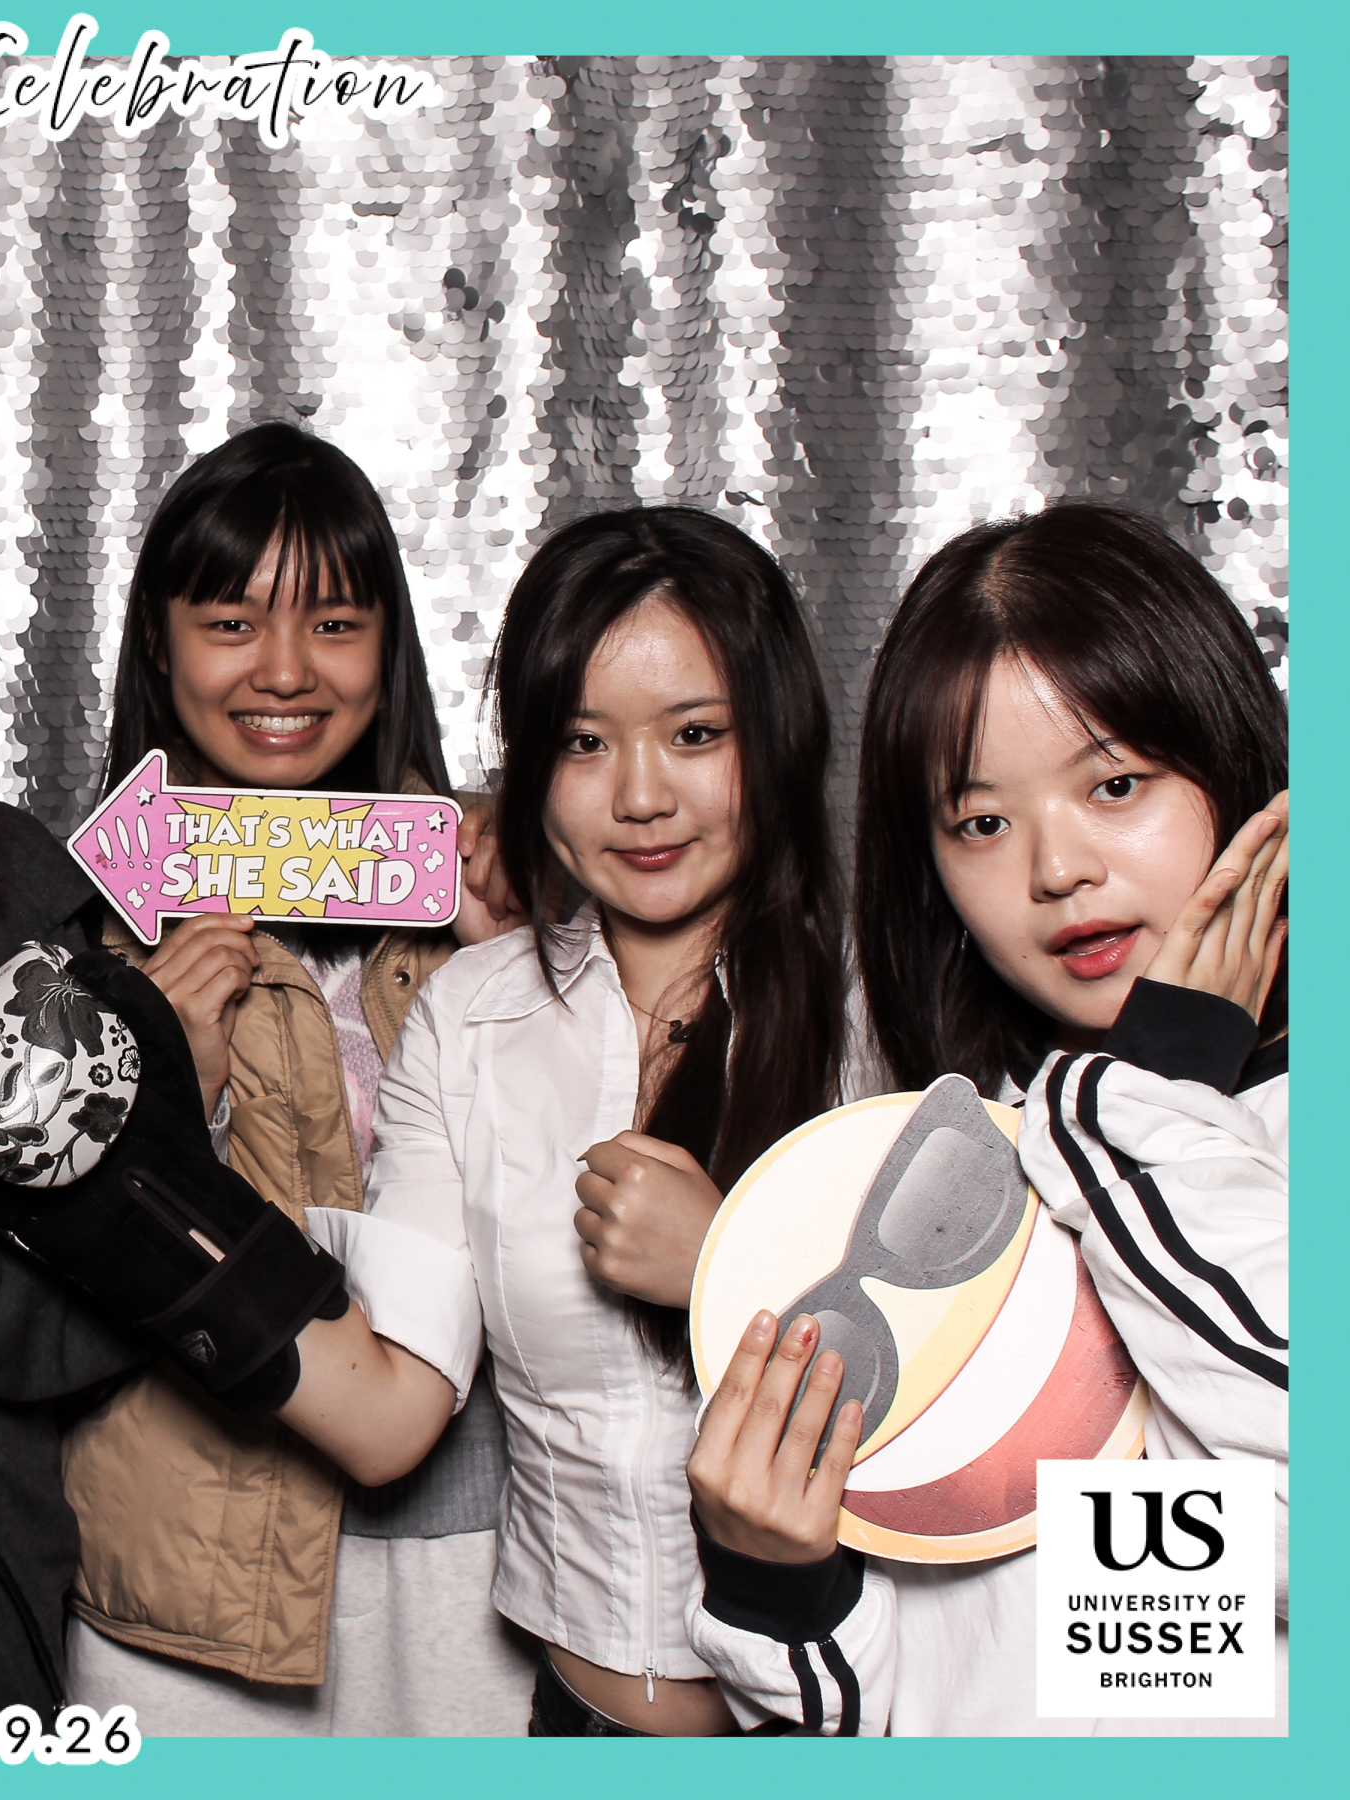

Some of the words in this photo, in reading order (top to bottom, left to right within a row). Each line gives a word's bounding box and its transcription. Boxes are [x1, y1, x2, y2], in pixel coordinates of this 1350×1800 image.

[164, 811, 291, 849] THAT'S
[299, 819, 414, 853] WHAT
[160, 853, 266, 900] SHE
[278, 856, 417, 905] SAID
